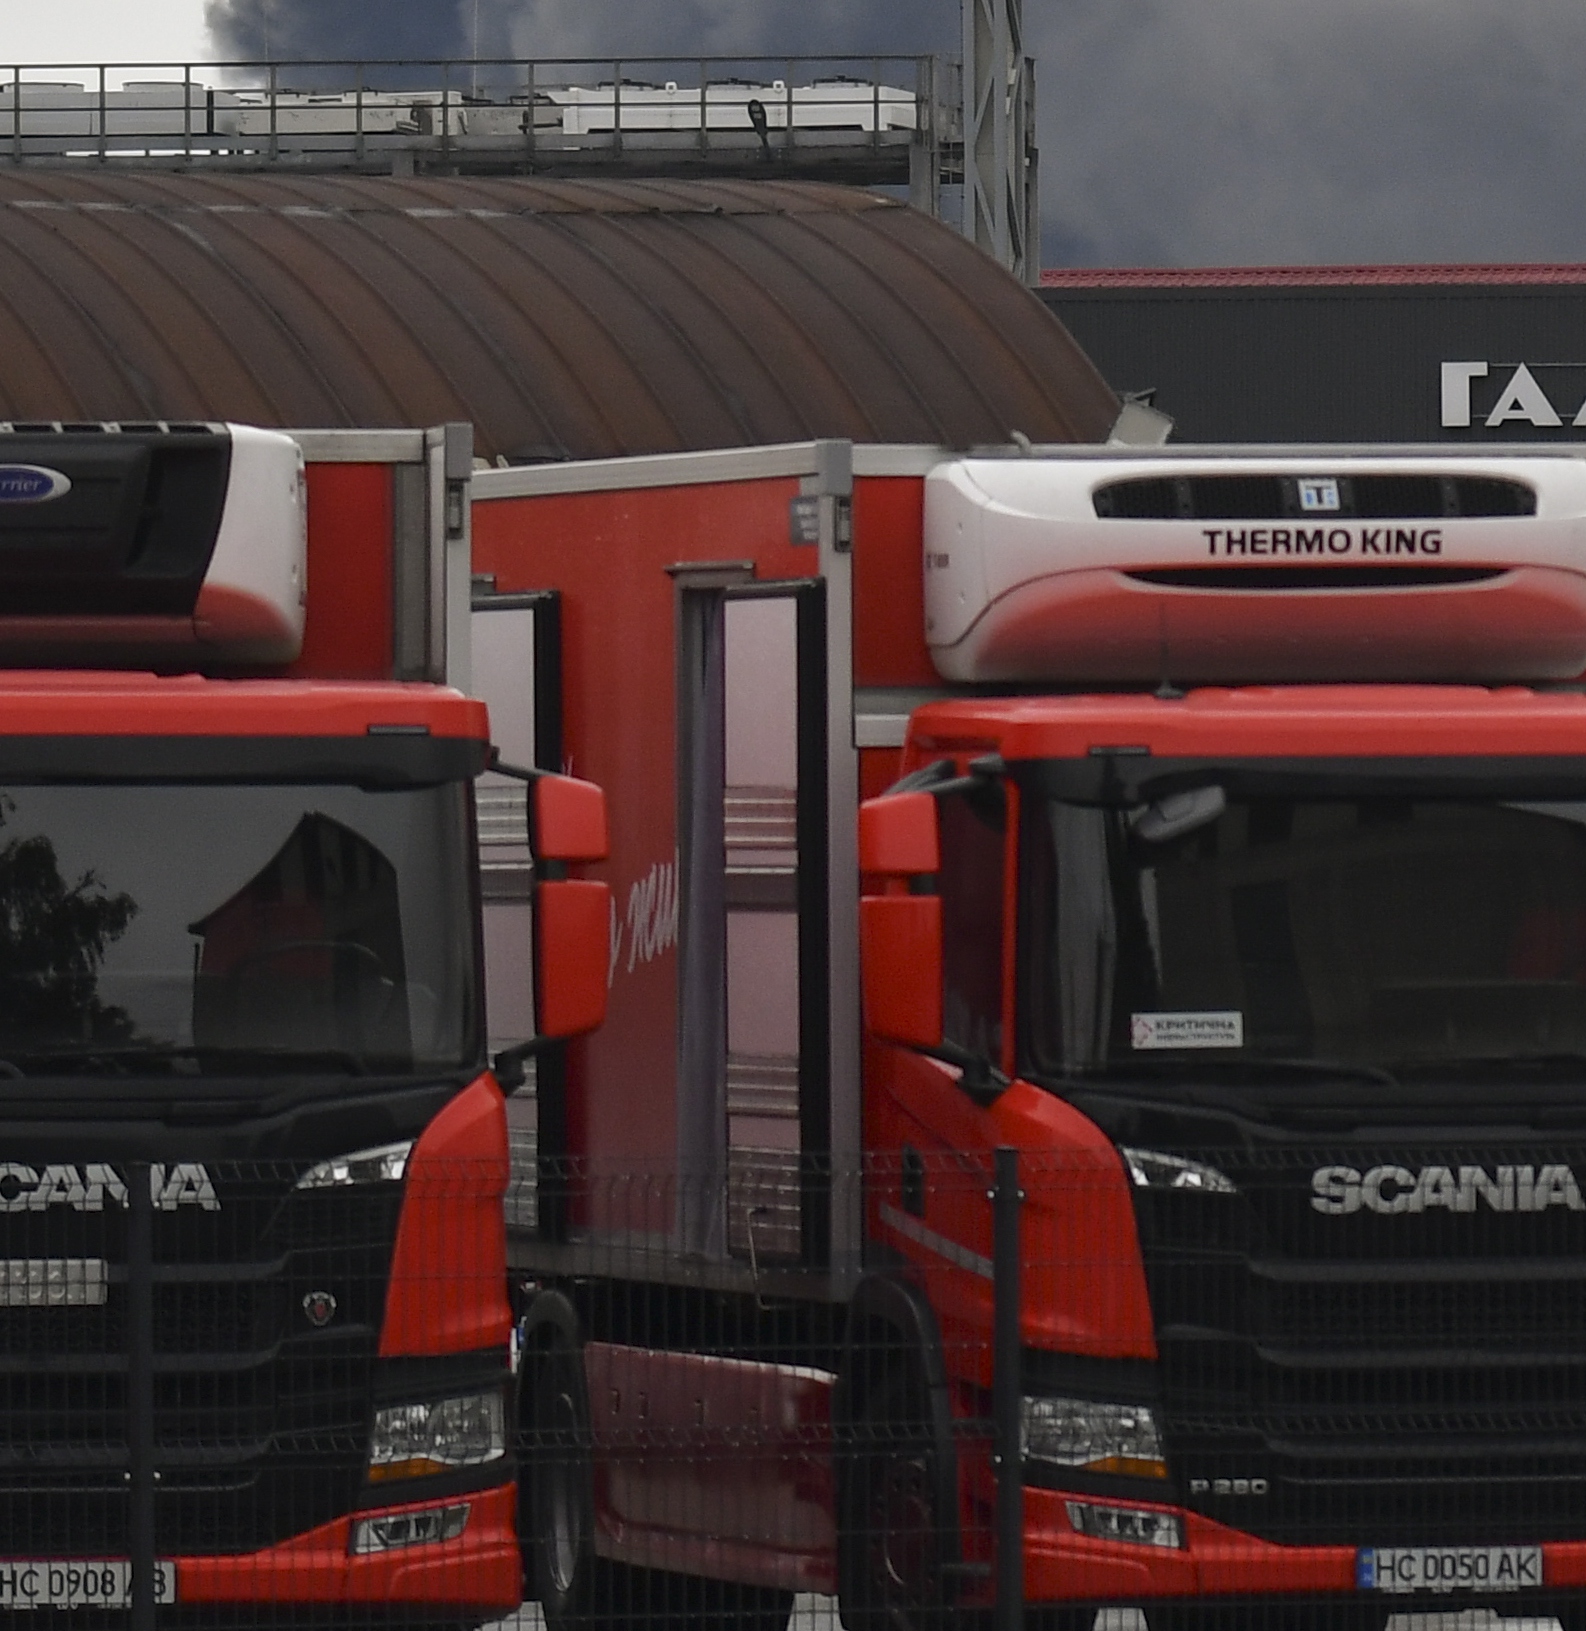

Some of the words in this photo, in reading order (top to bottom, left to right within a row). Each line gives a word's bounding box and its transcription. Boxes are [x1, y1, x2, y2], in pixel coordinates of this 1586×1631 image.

[1203, 529, 1352, 556] THERMO
[1361, 529, 1443, 556] KING
[1310, 1164, 1586, 1214] SCANIA
[1376, 1554, 1416, 1581] HC
[1423, 1553, 1490, 1580] 0050
[1497, 1553, 1537, 1580] AK
[0, 1570, 40, 1597] HC
[50, 1569, 116, 1597] 0908
